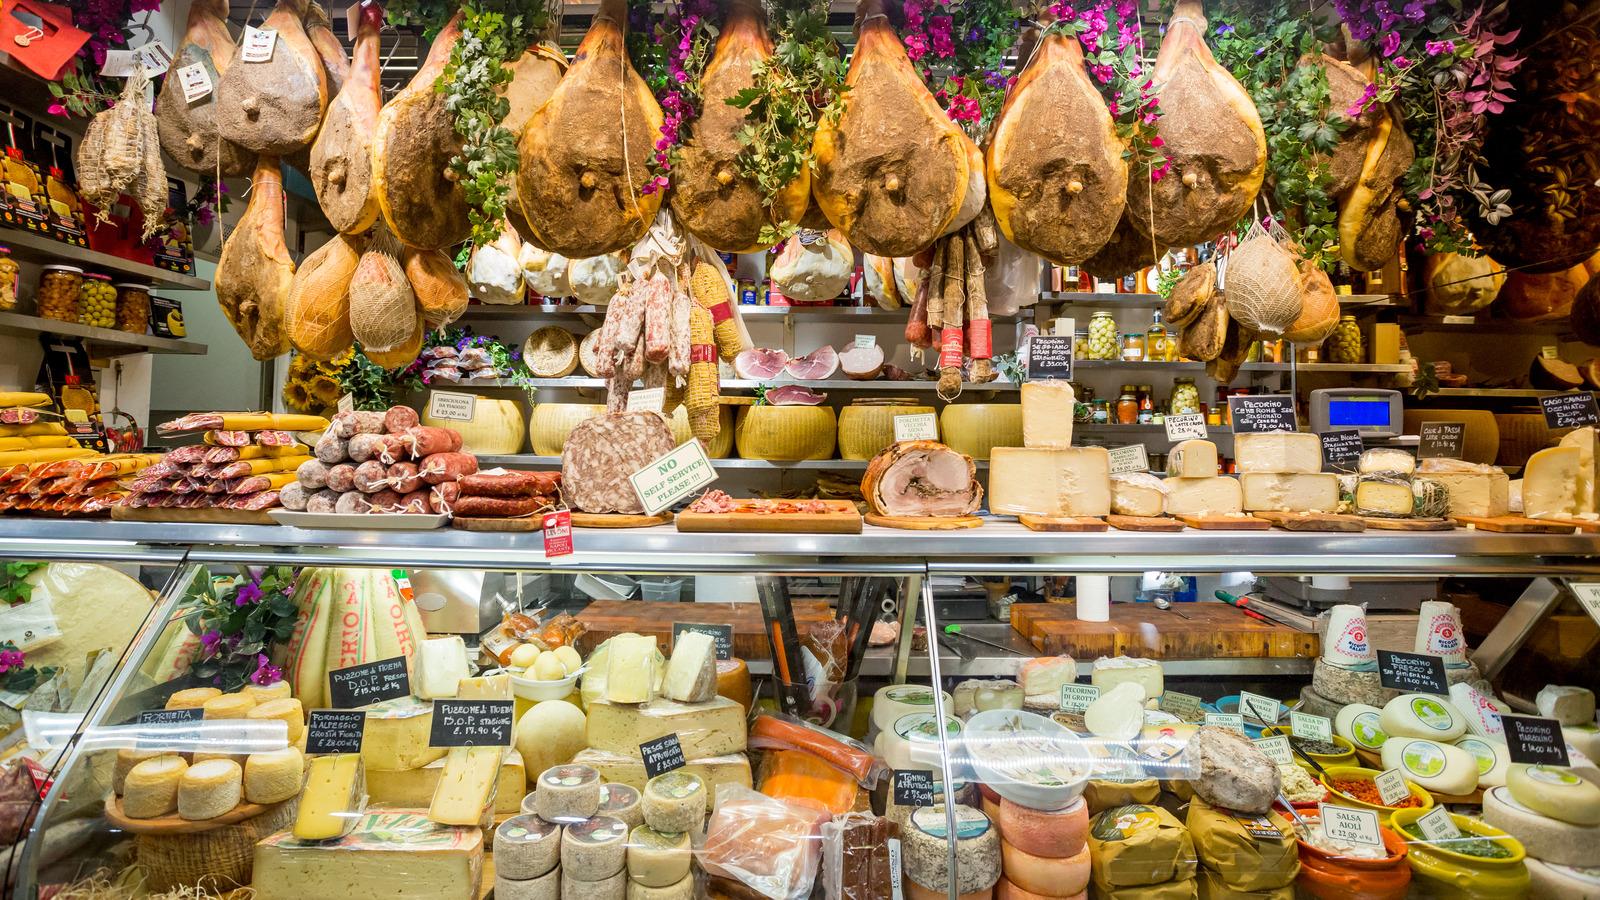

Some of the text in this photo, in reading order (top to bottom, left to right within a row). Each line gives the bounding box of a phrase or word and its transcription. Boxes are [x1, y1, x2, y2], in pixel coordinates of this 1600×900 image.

[1155, 339, 1164, 351] 6
[437, 397, 470, 405] SBRICIOLONA
[1244, 400, 1282, 408] PECORINO
[657, 459, 677, 476] NO
[643, 458, 704, 498] SELF SERVICE
[657, 478, 691, 502] PLEASE
[547, 528, 569, 536] LEVONI
[1390, 654, 1431, 667] PECORINO
[1390, 663, 1425, 673] FRESCO
[333, 668, 369, 682] PUZZONE
[1065, 687, 1097, 695] PECORINO
[1072, 694, 1097, 702] GROTTA
[1297, 716, 1316, 724] SALSA
[1302, 723, 1320, 731] OLIVE
[1515, 721, 1551, 735] PECORINO
[310, 730, 337, 738] CROSTA
[899, 772, 926, 782] TONNO
[1383, 775, 1395, 784] SALSA
[1383, 781, 1401, 794] PICCANTE
[1336, 812, 1362, 822] SALSA
[1428, 815, 1443, 827] SALSA
[1433, 823, 1448, 834] VERDE
